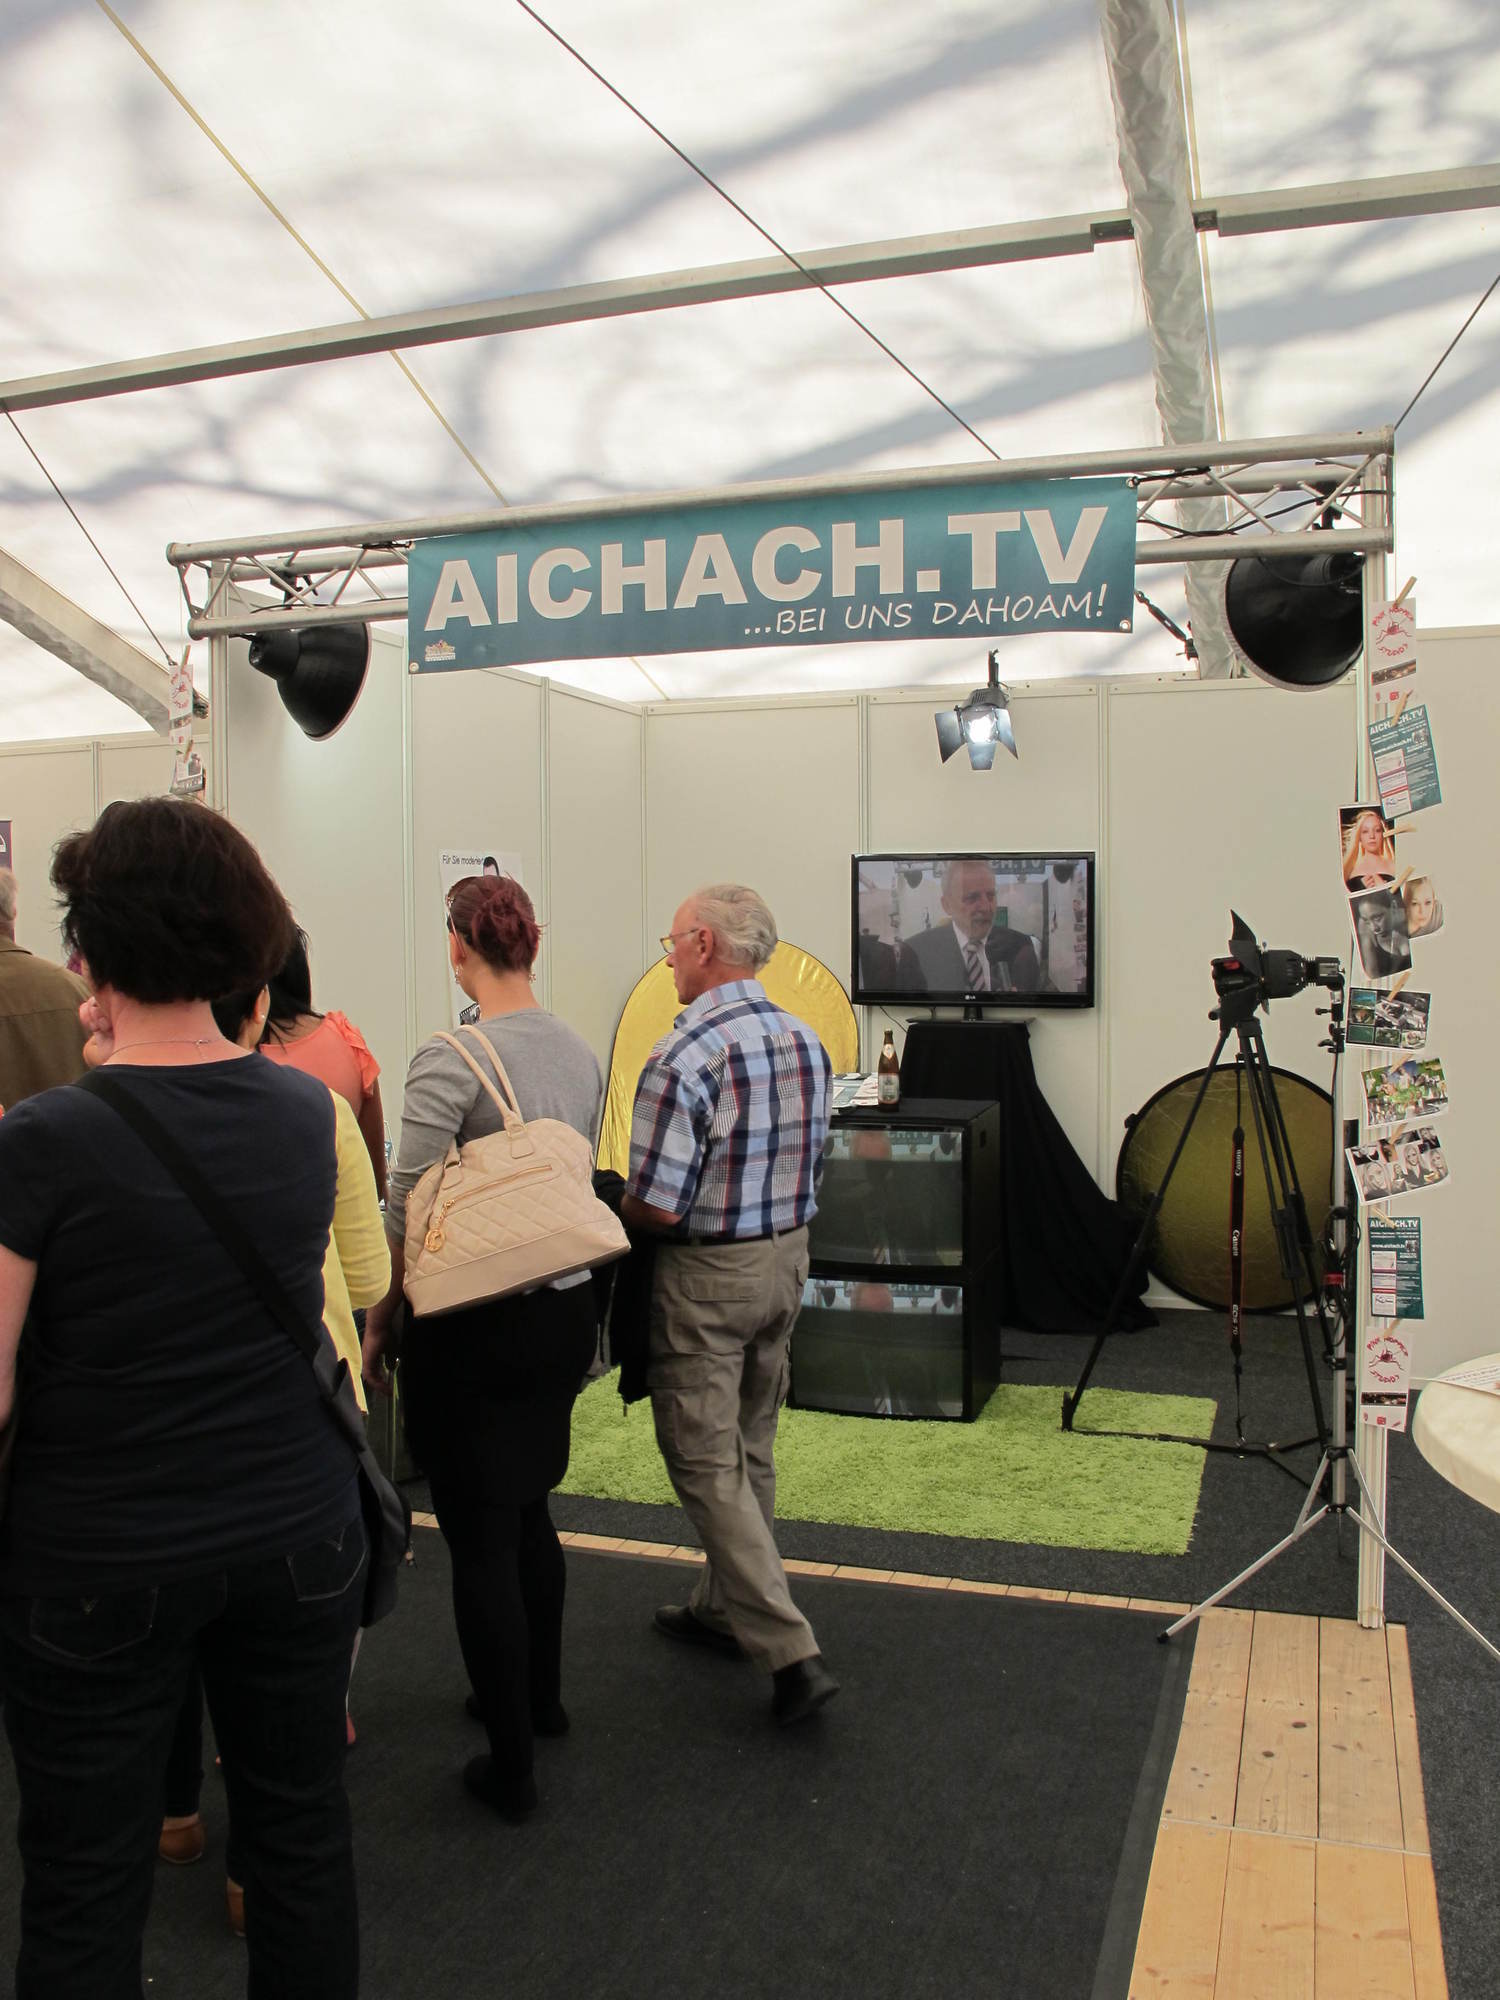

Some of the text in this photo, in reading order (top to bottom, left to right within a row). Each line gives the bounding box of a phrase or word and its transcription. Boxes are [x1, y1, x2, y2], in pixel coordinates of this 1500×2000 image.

[424, 507, 1109, 632] AICHACH.TV
[845, 602, 912, 630] UNS
[932, 583, 1106, 626] DAHOAM!
[1369, 708, 1424, 736] AICHCH.TV
[452, 855, 460, 865] Sie
[1234, 1149, 1242, 1177] Canon
[1369, 1219, 1418, 1229] AICCH.TV
[1232, 1229, 1241, 1257] Canon
